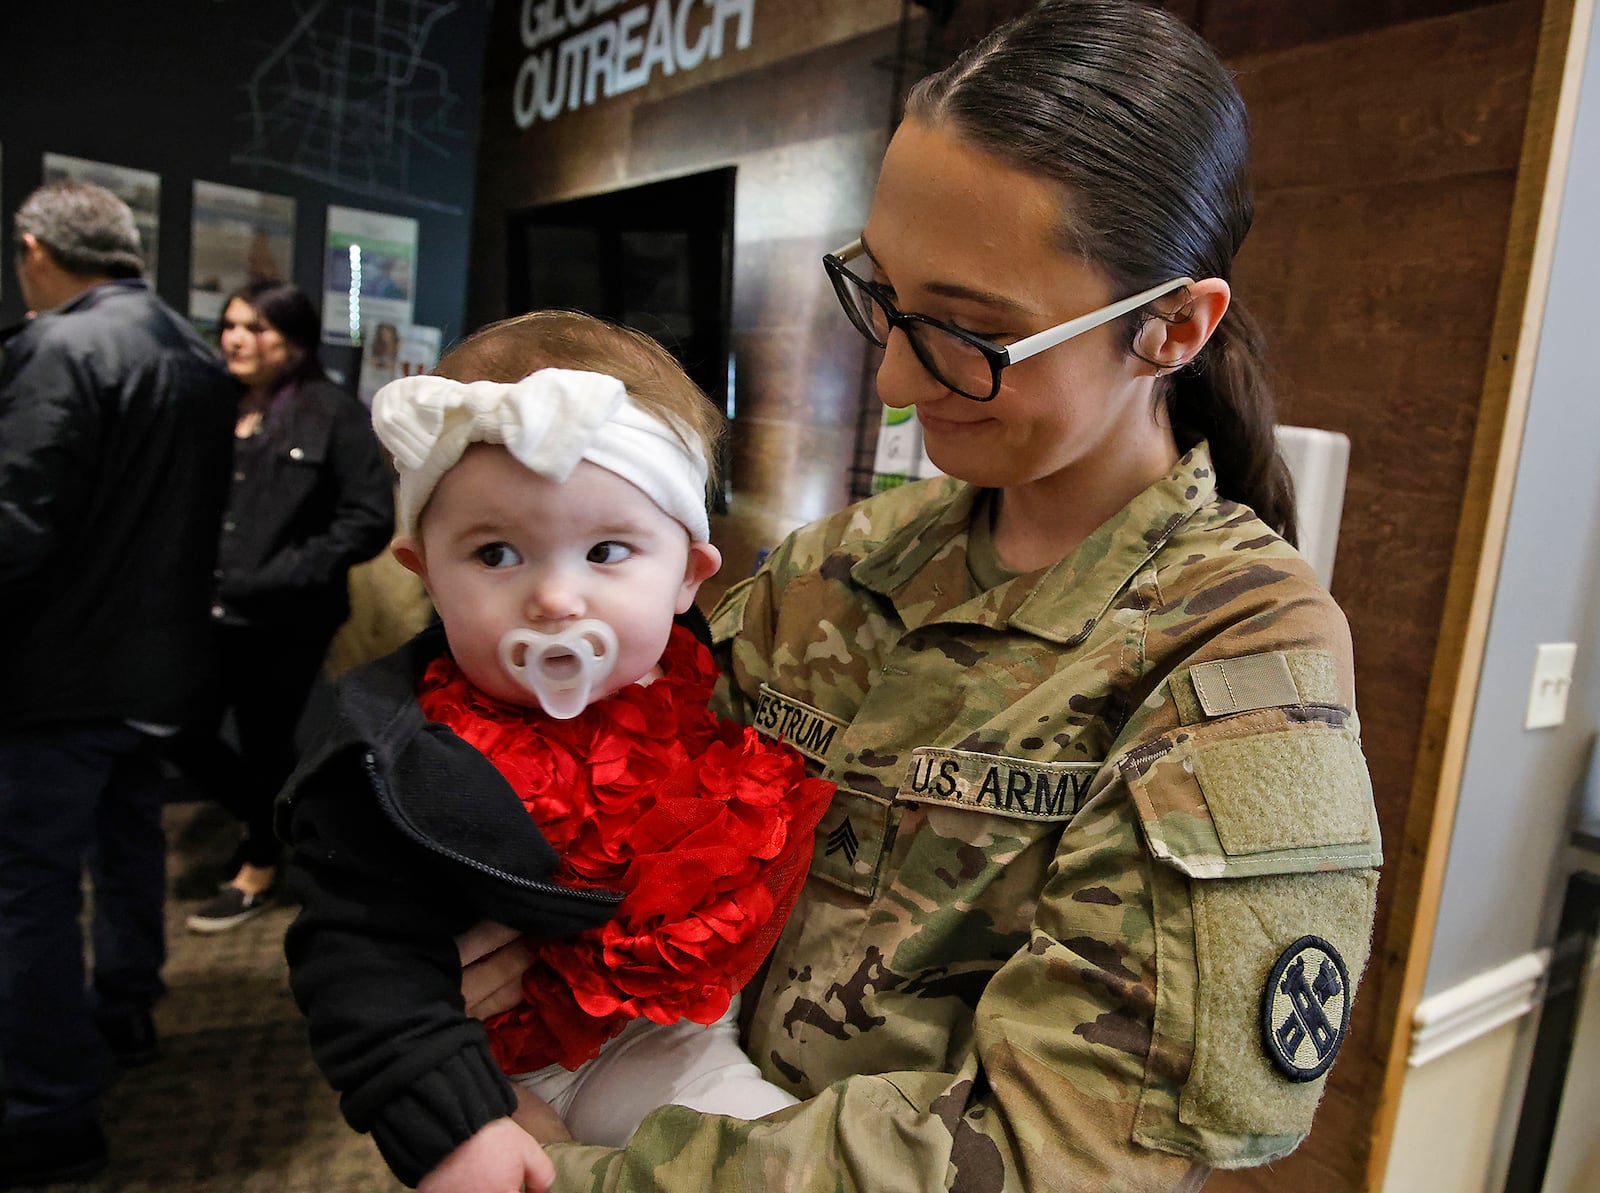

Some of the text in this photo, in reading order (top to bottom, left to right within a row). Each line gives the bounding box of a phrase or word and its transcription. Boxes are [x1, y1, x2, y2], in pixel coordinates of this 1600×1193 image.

[513, 0, 754, 129] OUTREACH
[911, 758, 1094, 815] U.S. ARMY
